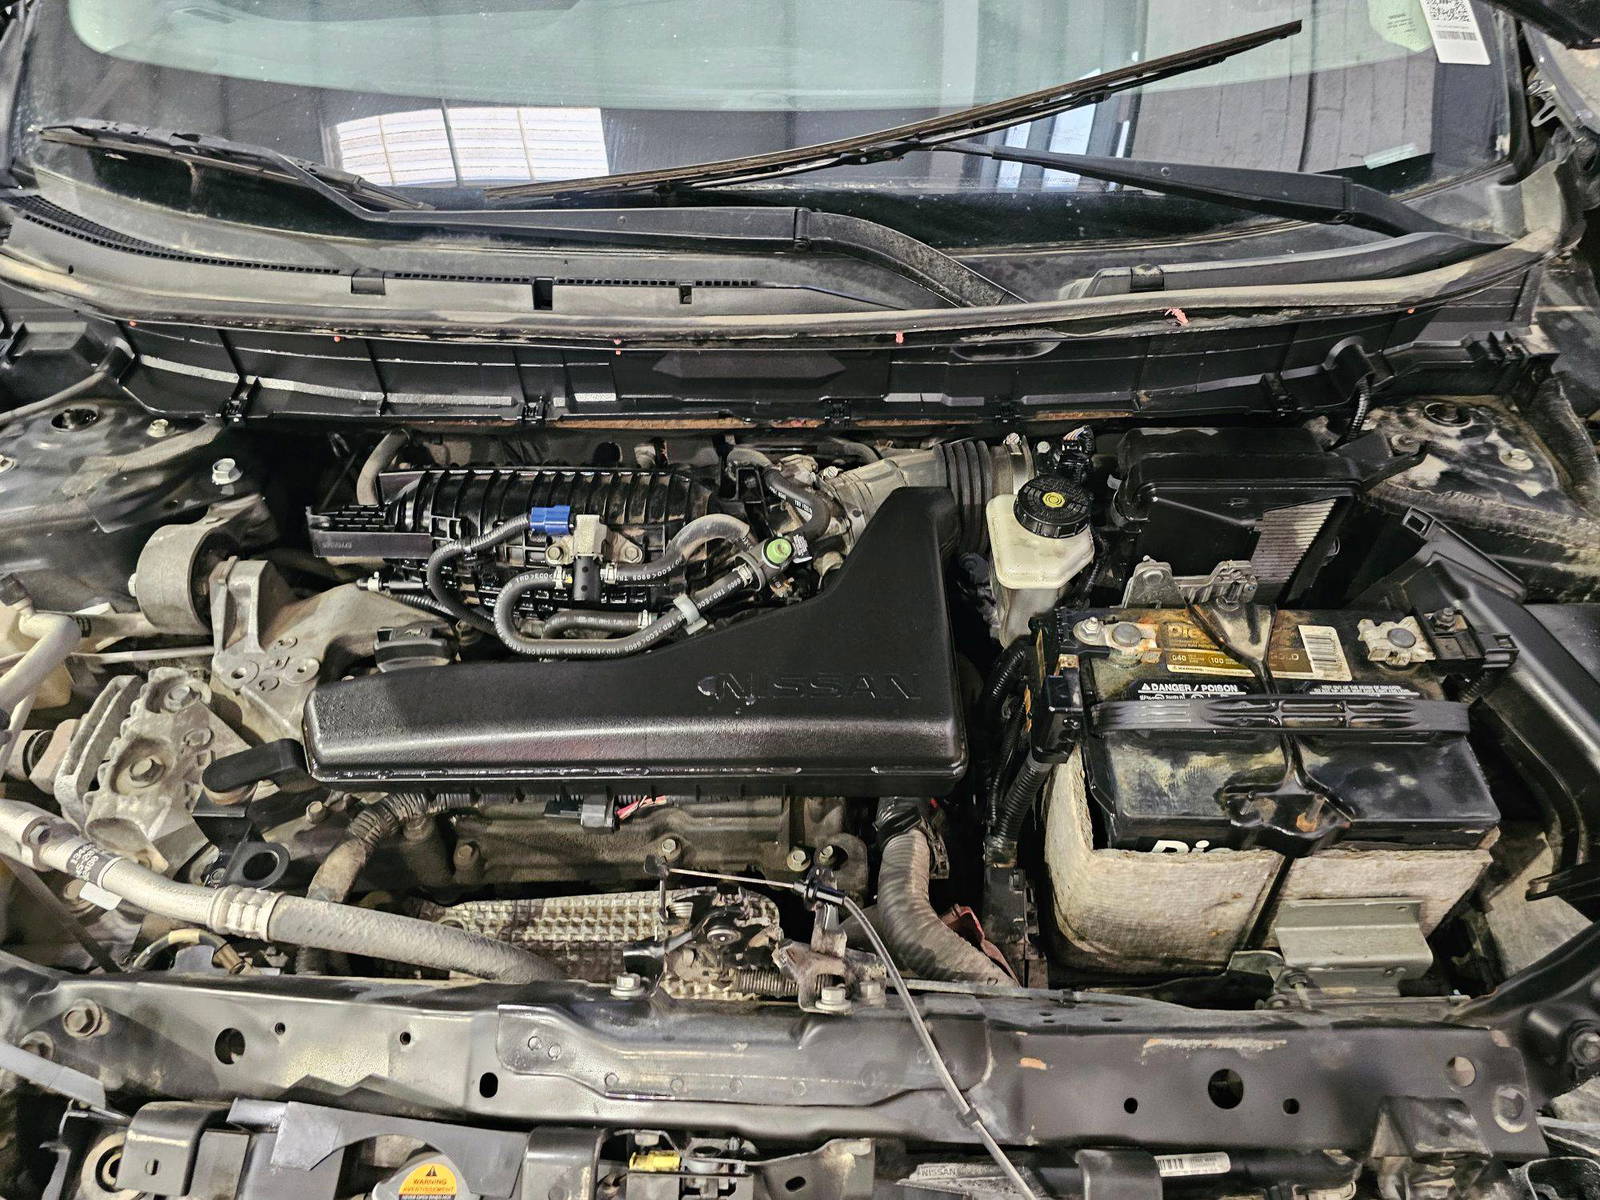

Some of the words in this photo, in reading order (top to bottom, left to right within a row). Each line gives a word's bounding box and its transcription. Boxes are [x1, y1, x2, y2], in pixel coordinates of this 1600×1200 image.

[720, 672, 921, 700] NISSAN
[1151, 684, 1191, 692] DANGER
[1201, 685, 1238, 693] POISON
[921, 1167, 956, 1177] NISSAN
